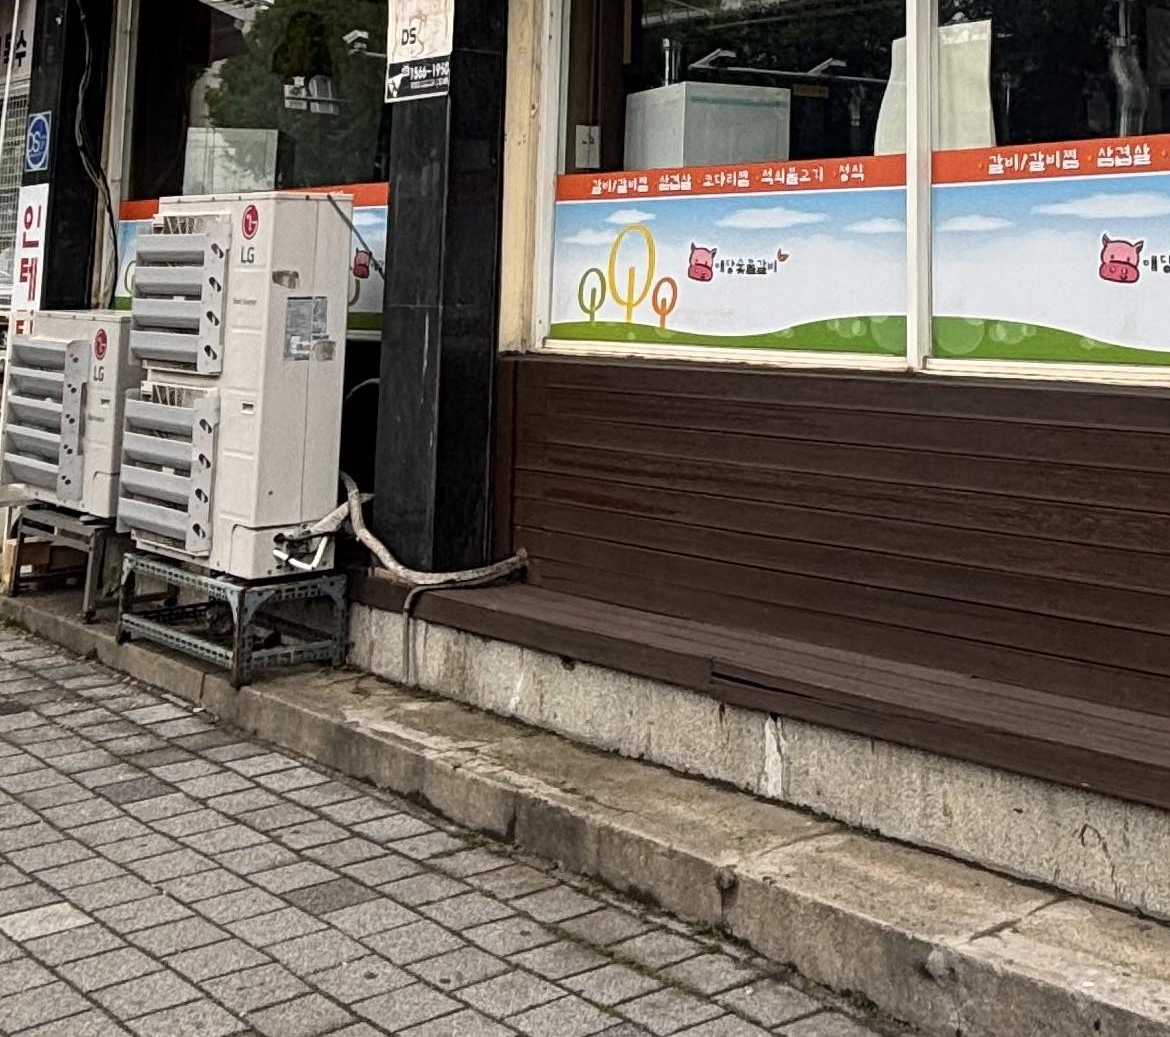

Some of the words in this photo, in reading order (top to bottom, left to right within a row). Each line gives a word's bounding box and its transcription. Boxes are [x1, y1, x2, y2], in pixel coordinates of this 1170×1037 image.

[987, 148, 1080, 175] 갈비/갈비찜
[1097, 142, 1152, 168] 삼겹살
[240, 246, 255, 263] LG
[93, 365, 105, 382] LG
